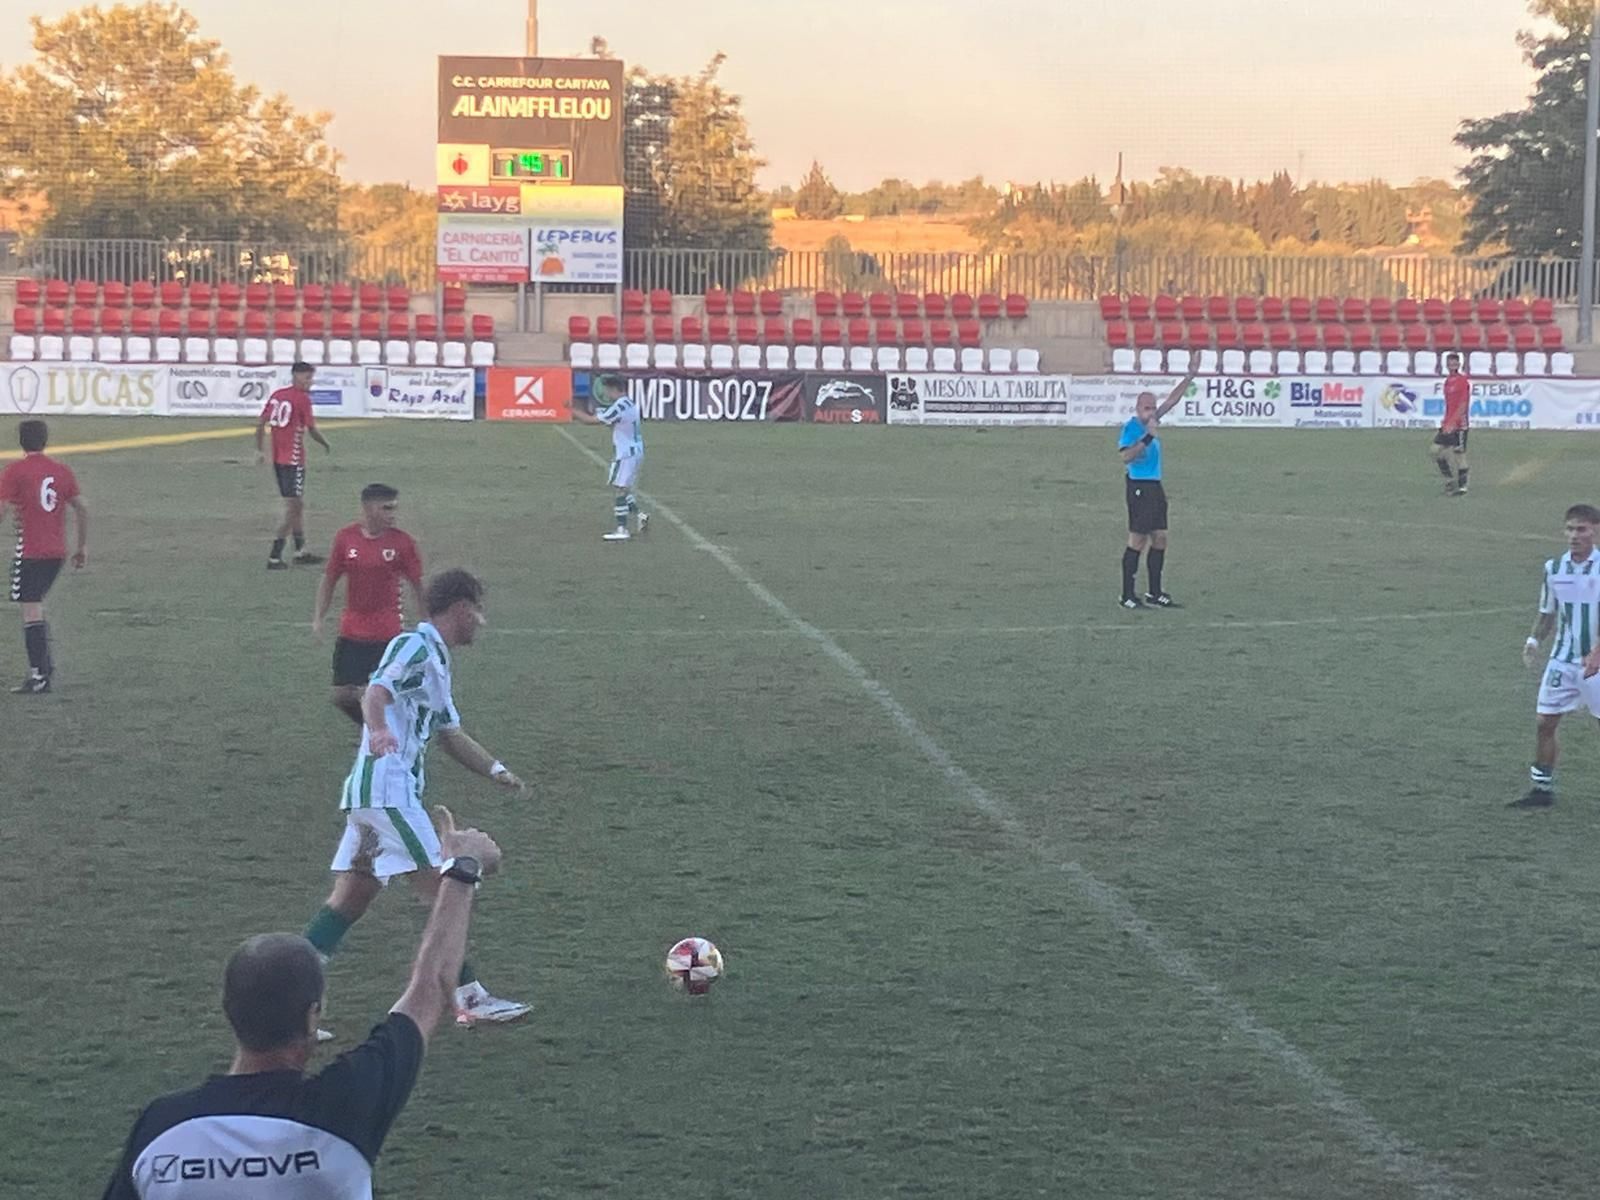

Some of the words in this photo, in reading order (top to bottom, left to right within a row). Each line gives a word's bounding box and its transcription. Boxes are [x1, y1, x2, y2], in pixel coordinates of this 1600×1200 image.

[452, 75, 476, 88] C.C.
[478, 76, 553, 90] CARREFOUR
[555, 78, 611, 91] CARTAYA
[537, 230, 617, 244] LEPEBUS
[47, 367, 155, 407] LUCAS
[432, 389, 467, 405] Azul
[924, 377, 977, 398] MESÓN
[982, 380, 1001, 399] LA
[1005, 381, 1067, 399] TABLITA
[1206, 379, 1255, 399] H&G
[1291, 382, 1364, 407] BigMat
[1433, 382, 1522, 397] FETERIA
[627, 378, 773, 420] IMPULSO27
[1185, 402, 1206, 416] EL
[1211, 402, 1275, 417] CASINO
[269, 398, 292, 428] 20
[40, 476, 57, 512] 6
[181, 1150, 320, 1180] GIVOVA
